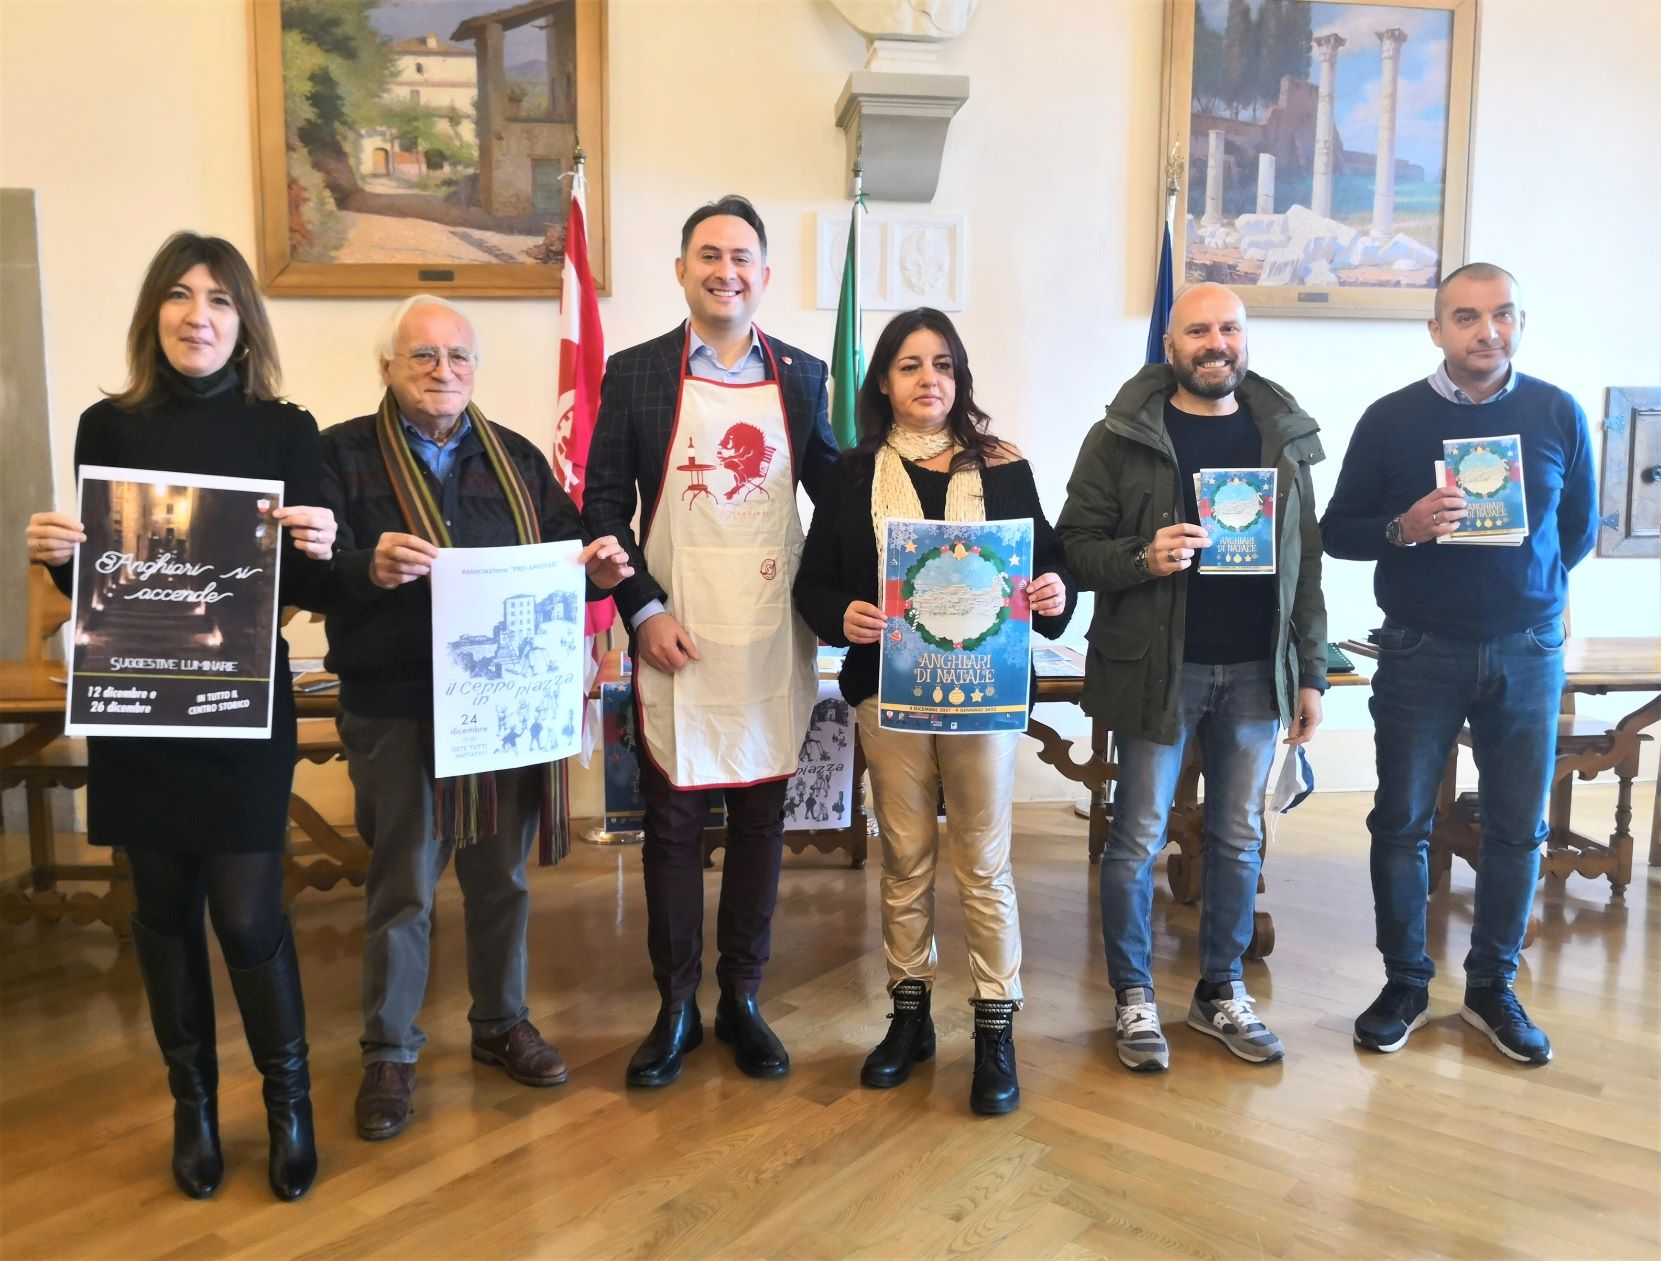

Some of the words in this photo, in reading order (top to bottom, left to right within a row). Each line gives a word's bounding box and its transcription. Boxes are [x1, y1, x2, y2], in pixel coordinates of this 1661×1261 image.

[1220, 536, 1255, 545] ANGHIARI
[1216, 544, 1226, 553] DI
[1228, 544, 1258, 553] NATALE
[95, 550, 214, 581] Anghiari
[220, 565, 264, 579] si
[461, 567, 508, 575] Associazione
[124, 581, 234, 603] accende
[110, 657, 178, 671] SUGGESTIVE
[919, 653, 992, 669] ANGHIARI
[914, 668, 931, 683] DI
[936, 668, 995, 685] NATALE
[87, 686, 102, 698] 12
[103, 686, 148, 699] dicembre
[445, 681, 457, 696] il
[460, 680, 515, 697] Ceppo
[515, 673, 574, 699] piazza
[207, 691, 230, 702] TUTTO
[473, 692, 489, 706] in
[90, 701, 104, 713] 26
[106, 701, 151, 713] dicembre
[188, 703, 217, 715] CENTRO
[218, 699, 250, 711] STORICO
[461, 713, 478, 725] 24
[450, 726, 488, 735] dicembre
